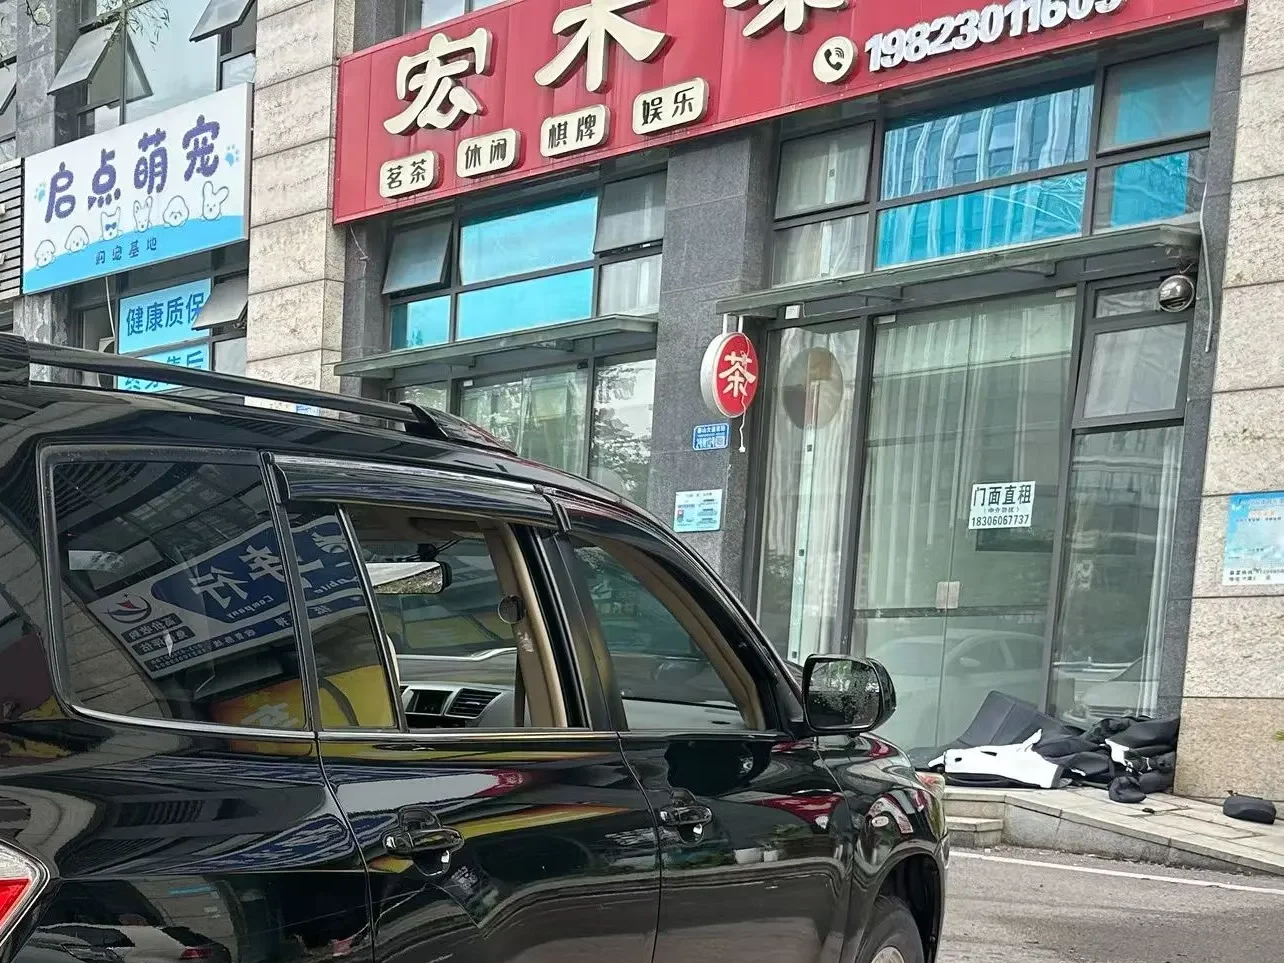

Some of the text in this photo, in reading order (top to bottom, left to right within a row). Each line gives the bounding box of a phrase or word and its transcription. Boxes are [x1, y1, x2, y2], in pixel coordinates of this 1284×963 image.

[641, 86, 695, 126] 娱乐
[547, 113, 597, 149] 棋牌
[44, 114, 221, 224] 启点萌宠
[464, 138, 508, 170] 休闲
[386, 159, 427, 190] 茗茶
[718, 351, 756, 397] 茶
[973, 484, 1031, 506] 门面直租
[971, 514, 1029, 527] 18306067737
